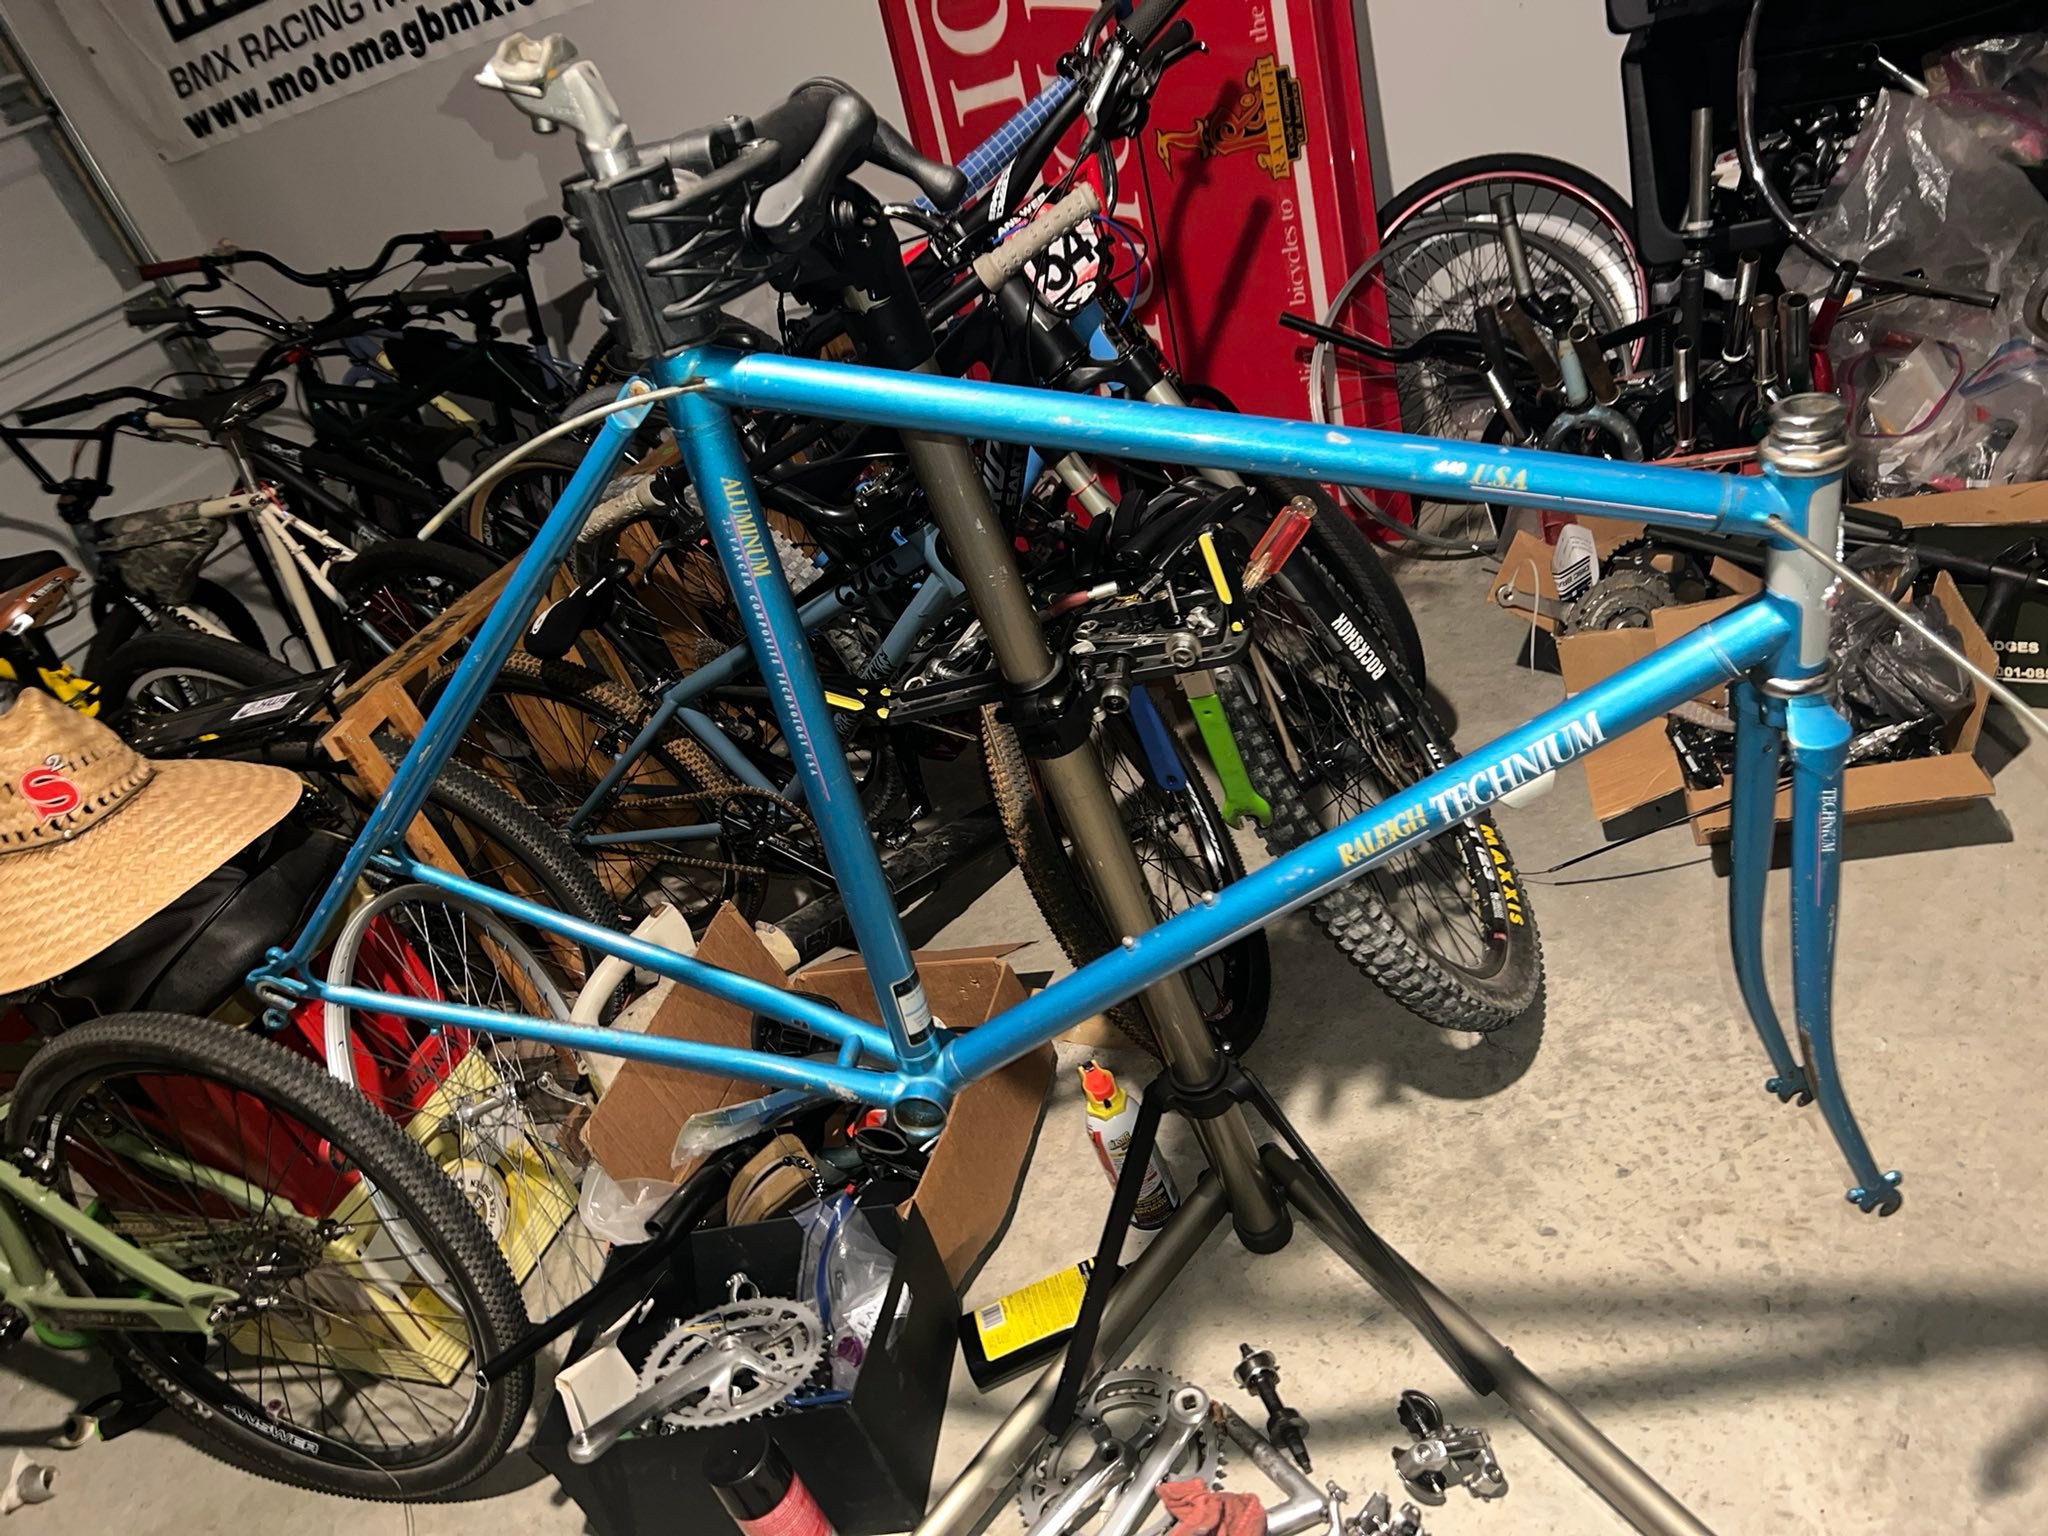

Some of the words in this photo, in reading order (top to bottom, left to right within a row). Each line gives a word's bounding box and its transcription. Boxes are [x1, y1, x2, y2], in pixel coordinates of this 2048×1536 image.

[169, 43, 241, 100] BMX
[237, 0, 366, 69] RACING
[183, 0, 537, 138] www.motomagbmx.
[1249, 5, 1269, 43] the
[1260, 60, 1288, 174] RALEIGH
[1281, 199, 1294, 223] to
[1281, 226, 1306, 307] bicycles
[720, 476, 772, 577] ALUMINUM
[749, 594, 780, 665] COMPOSITE
[776, 672, 809, 747] TECHNOLOGY
[805, 753, 818, 776] USA
[1331, 612, 1387, 681] ROCKSHOX
[1337, 803, 1430, 868] RALEIGH
[1429, 710, 1608, 825] TECHNIUM
[1821, 787, 1838, 852] TECHNIUM
[1480, 823, 1525, 926] MAXXIS
[223, 1403, 320, 1456] ANSWER
